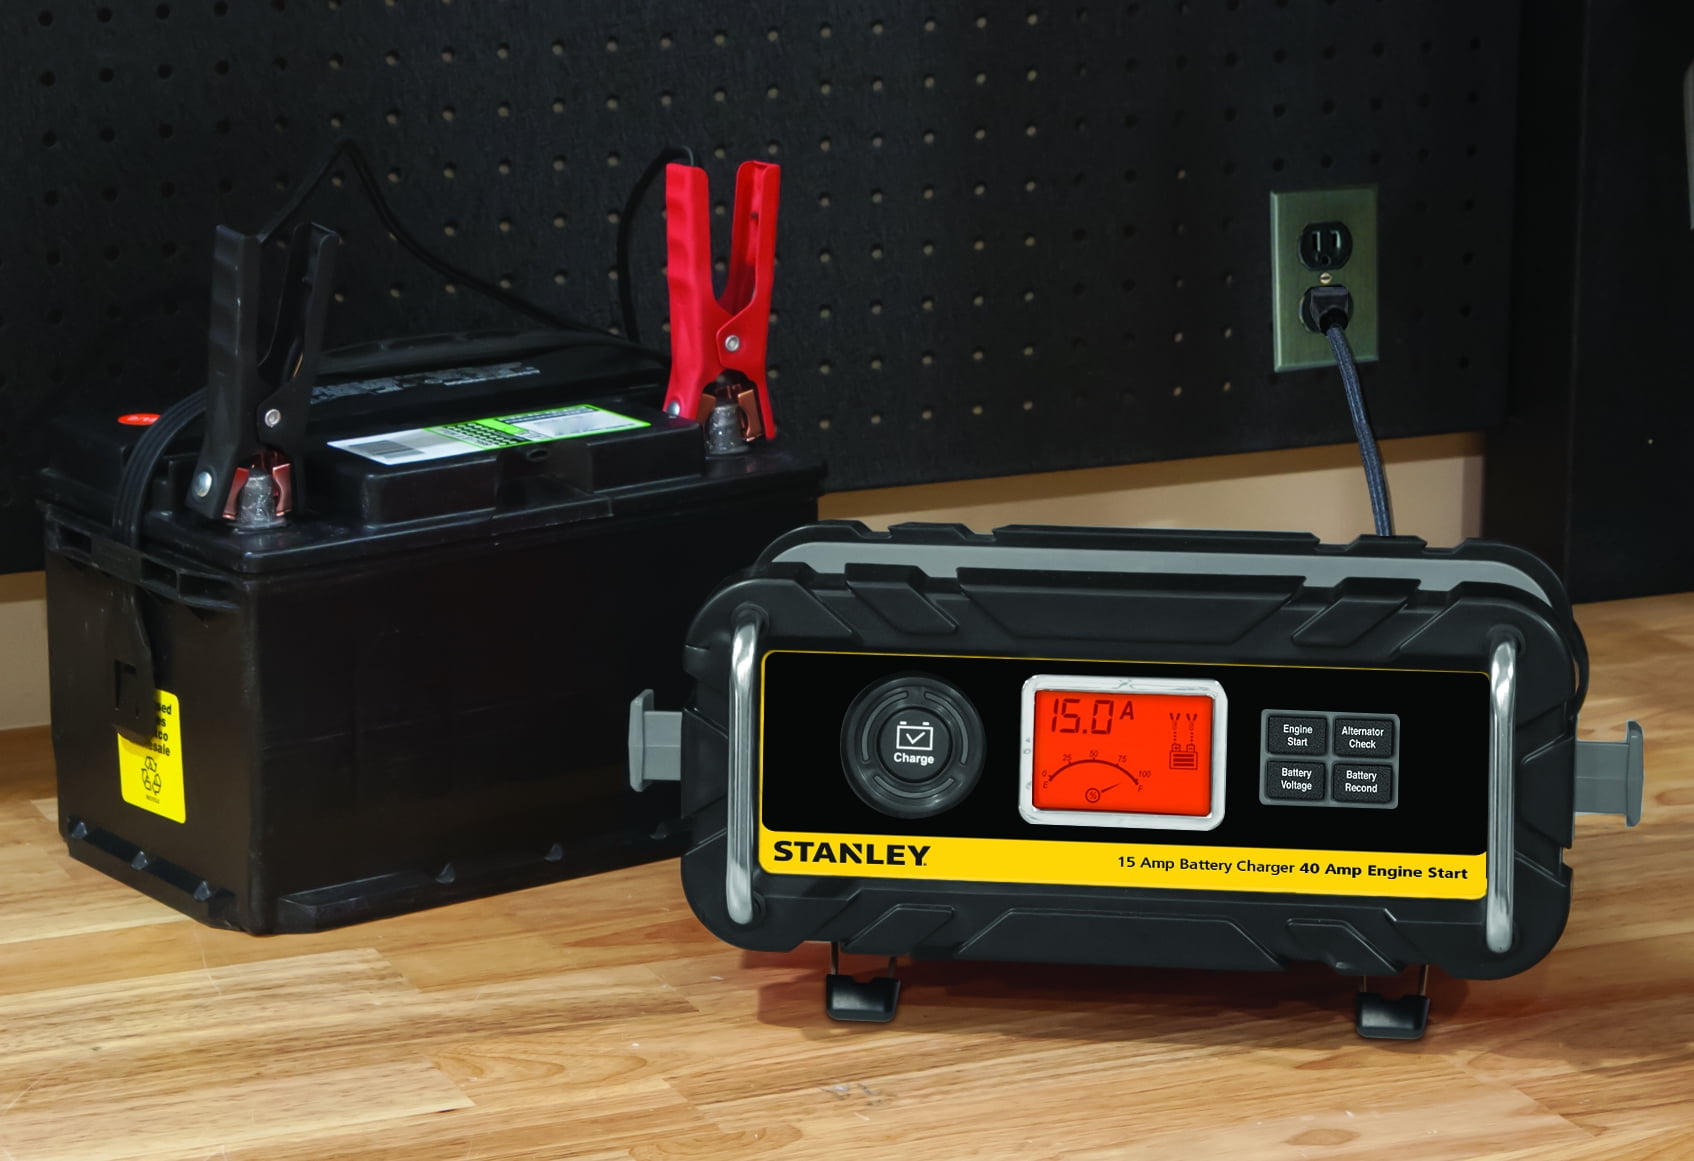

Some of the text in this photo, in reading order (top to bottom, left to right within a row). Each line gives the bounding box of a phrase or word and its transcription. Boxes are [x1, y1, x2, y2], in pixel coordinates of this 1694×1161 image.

[1051, 698, 1135, 735] 15.0 A
[1283, 724, 1313, 735] Engine
[1341, 726, 1384, 737] Alternator
[1287, 737, 1308, 747] Start
[1349, 739, 1376, 749] Check
[893, 752, 935, 766] Charge
[1062, 754, 1072, 762] 25
[1089, 750, 1098, 758] 50
[1118, 755, 1127, 763] 75
[1138, 770, 1151, 778] 100
[1281, 767, 1312, 779] Battery
[1346, 770, 1377, 782] Battery
[1281, 780, 1313, 792] Voltage
[1345, 782, 1378, 793] Recond
[773, 840, 931, 866] STANLEY
[1117, 856, 1469, 880] 15 Amp Battery Charger 40 Amp Engine Start
